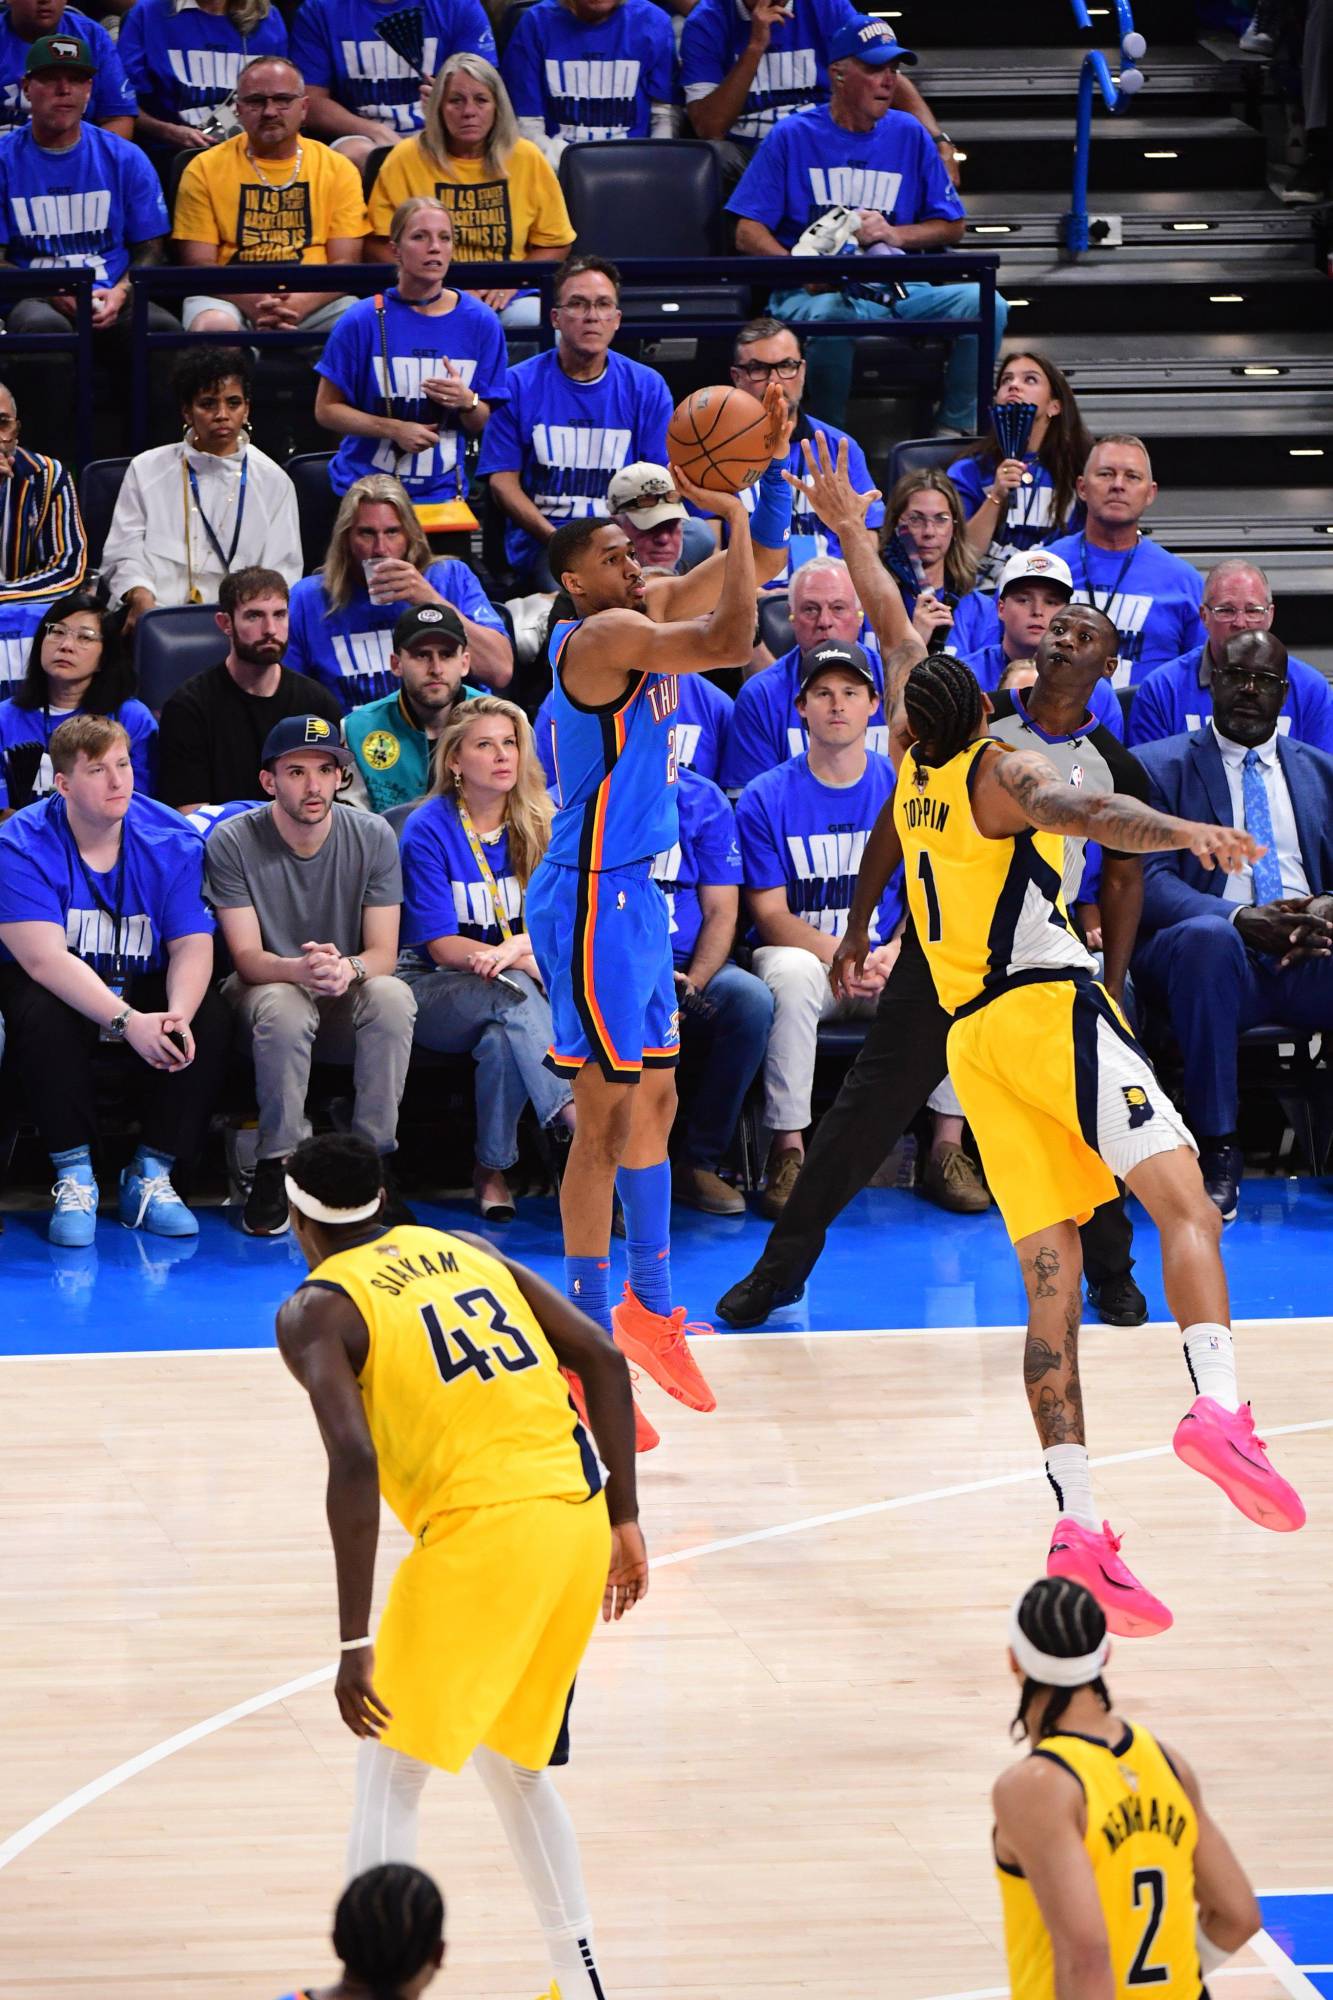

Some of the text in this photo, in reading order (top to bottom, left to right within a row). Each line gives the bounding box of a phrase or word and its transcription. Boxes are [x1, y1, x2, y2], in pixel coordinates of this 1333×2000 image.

[167, 50, 263, 91] LOU
[545, 59, 641, 101] LOUD
[735, 48, 818, 96] OUD
[262, 191, 279, 213] 49
[458, 190, 476, 210] 49
[808, 166, 903, 215] LOUD
[11, 190, 112, 239] LOUD
[449, 207, 506, 228] SKETBALL
[460, 227, 490, 247] THIS
[492, 226, 506, 247] IS
[412, 348, 438, 357] GET
[568, 418, 595, 427] GET
[532, 423, 632, 473] LOUD
[666, 727, 680, 785] 2
[827, 823, 856, 833] GET
[903, 797, 950, 833] TOPPIN
[786, 830, 872, 883] LOU
[451, 875, 525, 930] LOU
[918, 851, 942, 943] 1
[370, 1251, 460, 1296] SIAKAM
[419, 1287, 539, 1384] 43
[1127, 1868, 1169, 1985] 2
